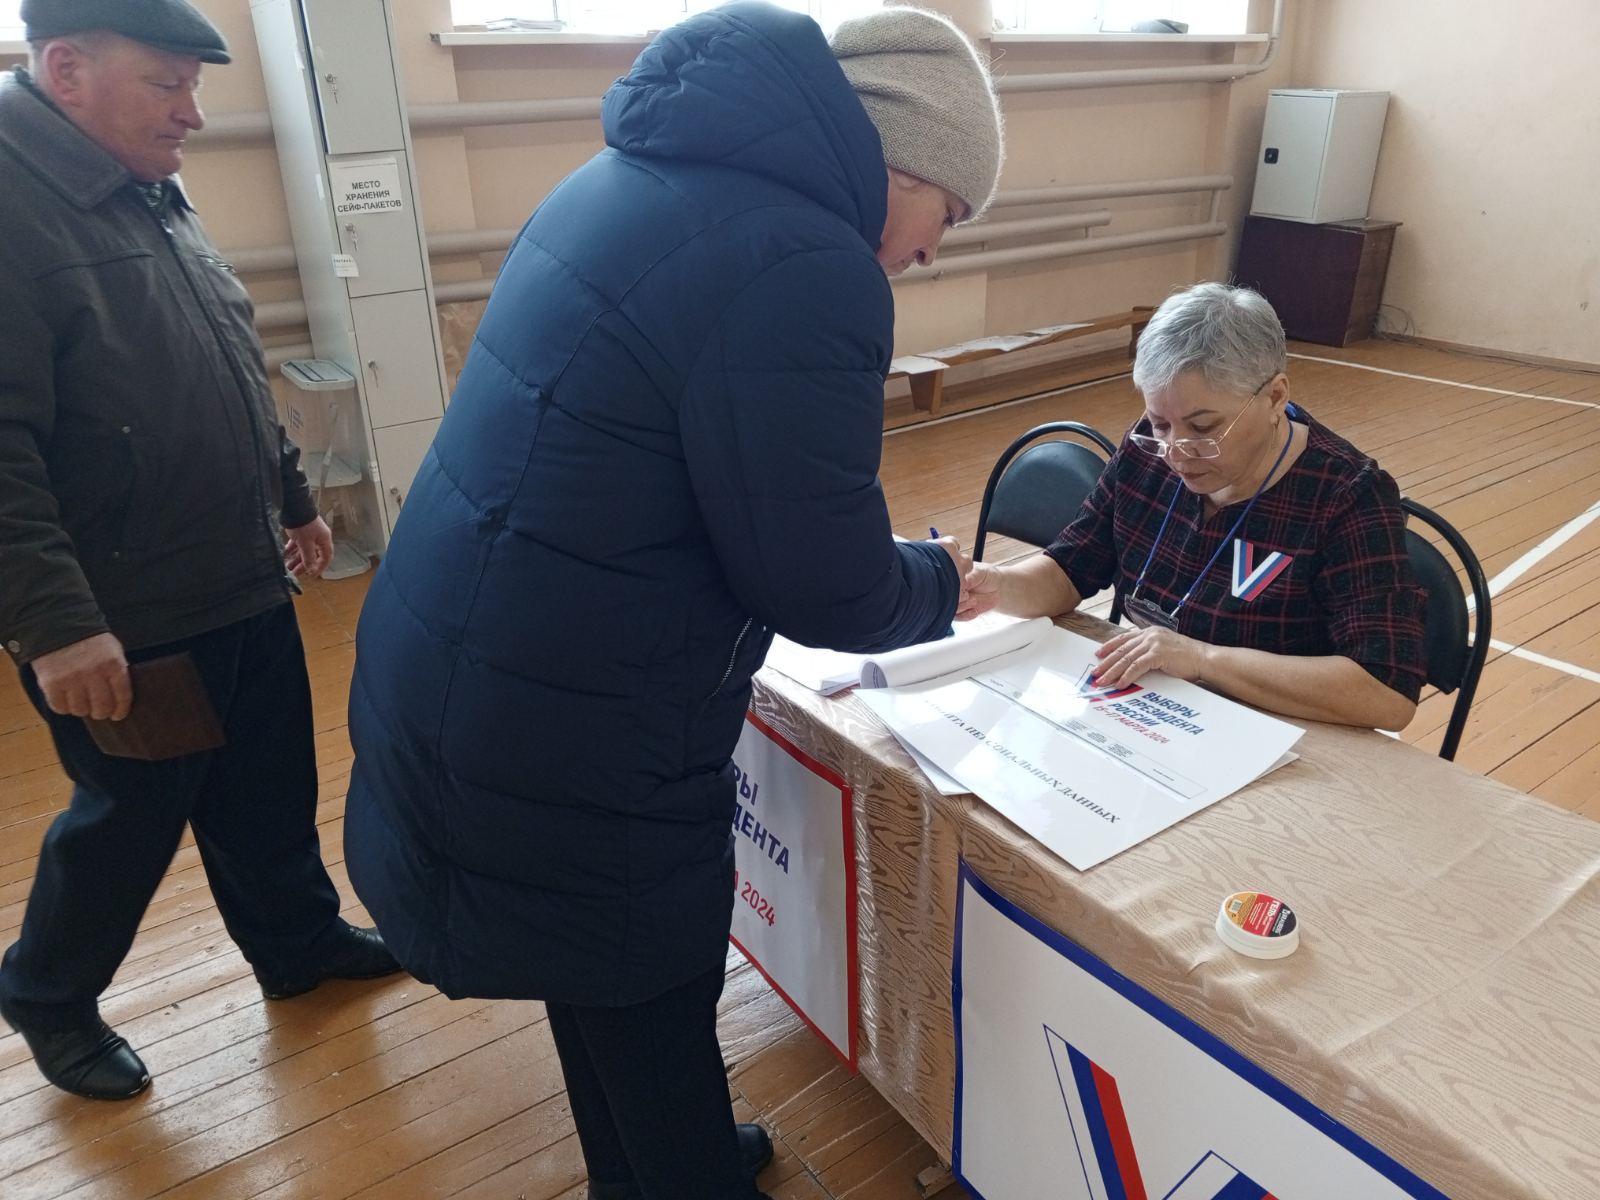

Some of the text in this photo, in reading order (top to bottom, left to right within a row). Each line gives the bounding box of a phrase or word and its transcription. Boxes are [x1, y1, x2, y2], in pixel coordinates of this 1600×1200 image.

[345, 190, 390, 201] ХРАНЕНИЯ
[352, 180, 381, 190] МЕСТО
[337, 200, 402, 212] СЕЙФ-ПАКЕТОВ
[1108, 702, 1161, 726] РОССИИ
[1125, 698, 1205, 735] ПРЕЗИДЕНТА
[1142, 692, 1201, 718] ВЫБОРЫ
[1118, 716, 1149, 733] МАРТА
[1144, 731, 1171, 744] 2024
[1057, 786, 1120, 823] ДАННЫХ
[741, 881, 777, 927] 2024
